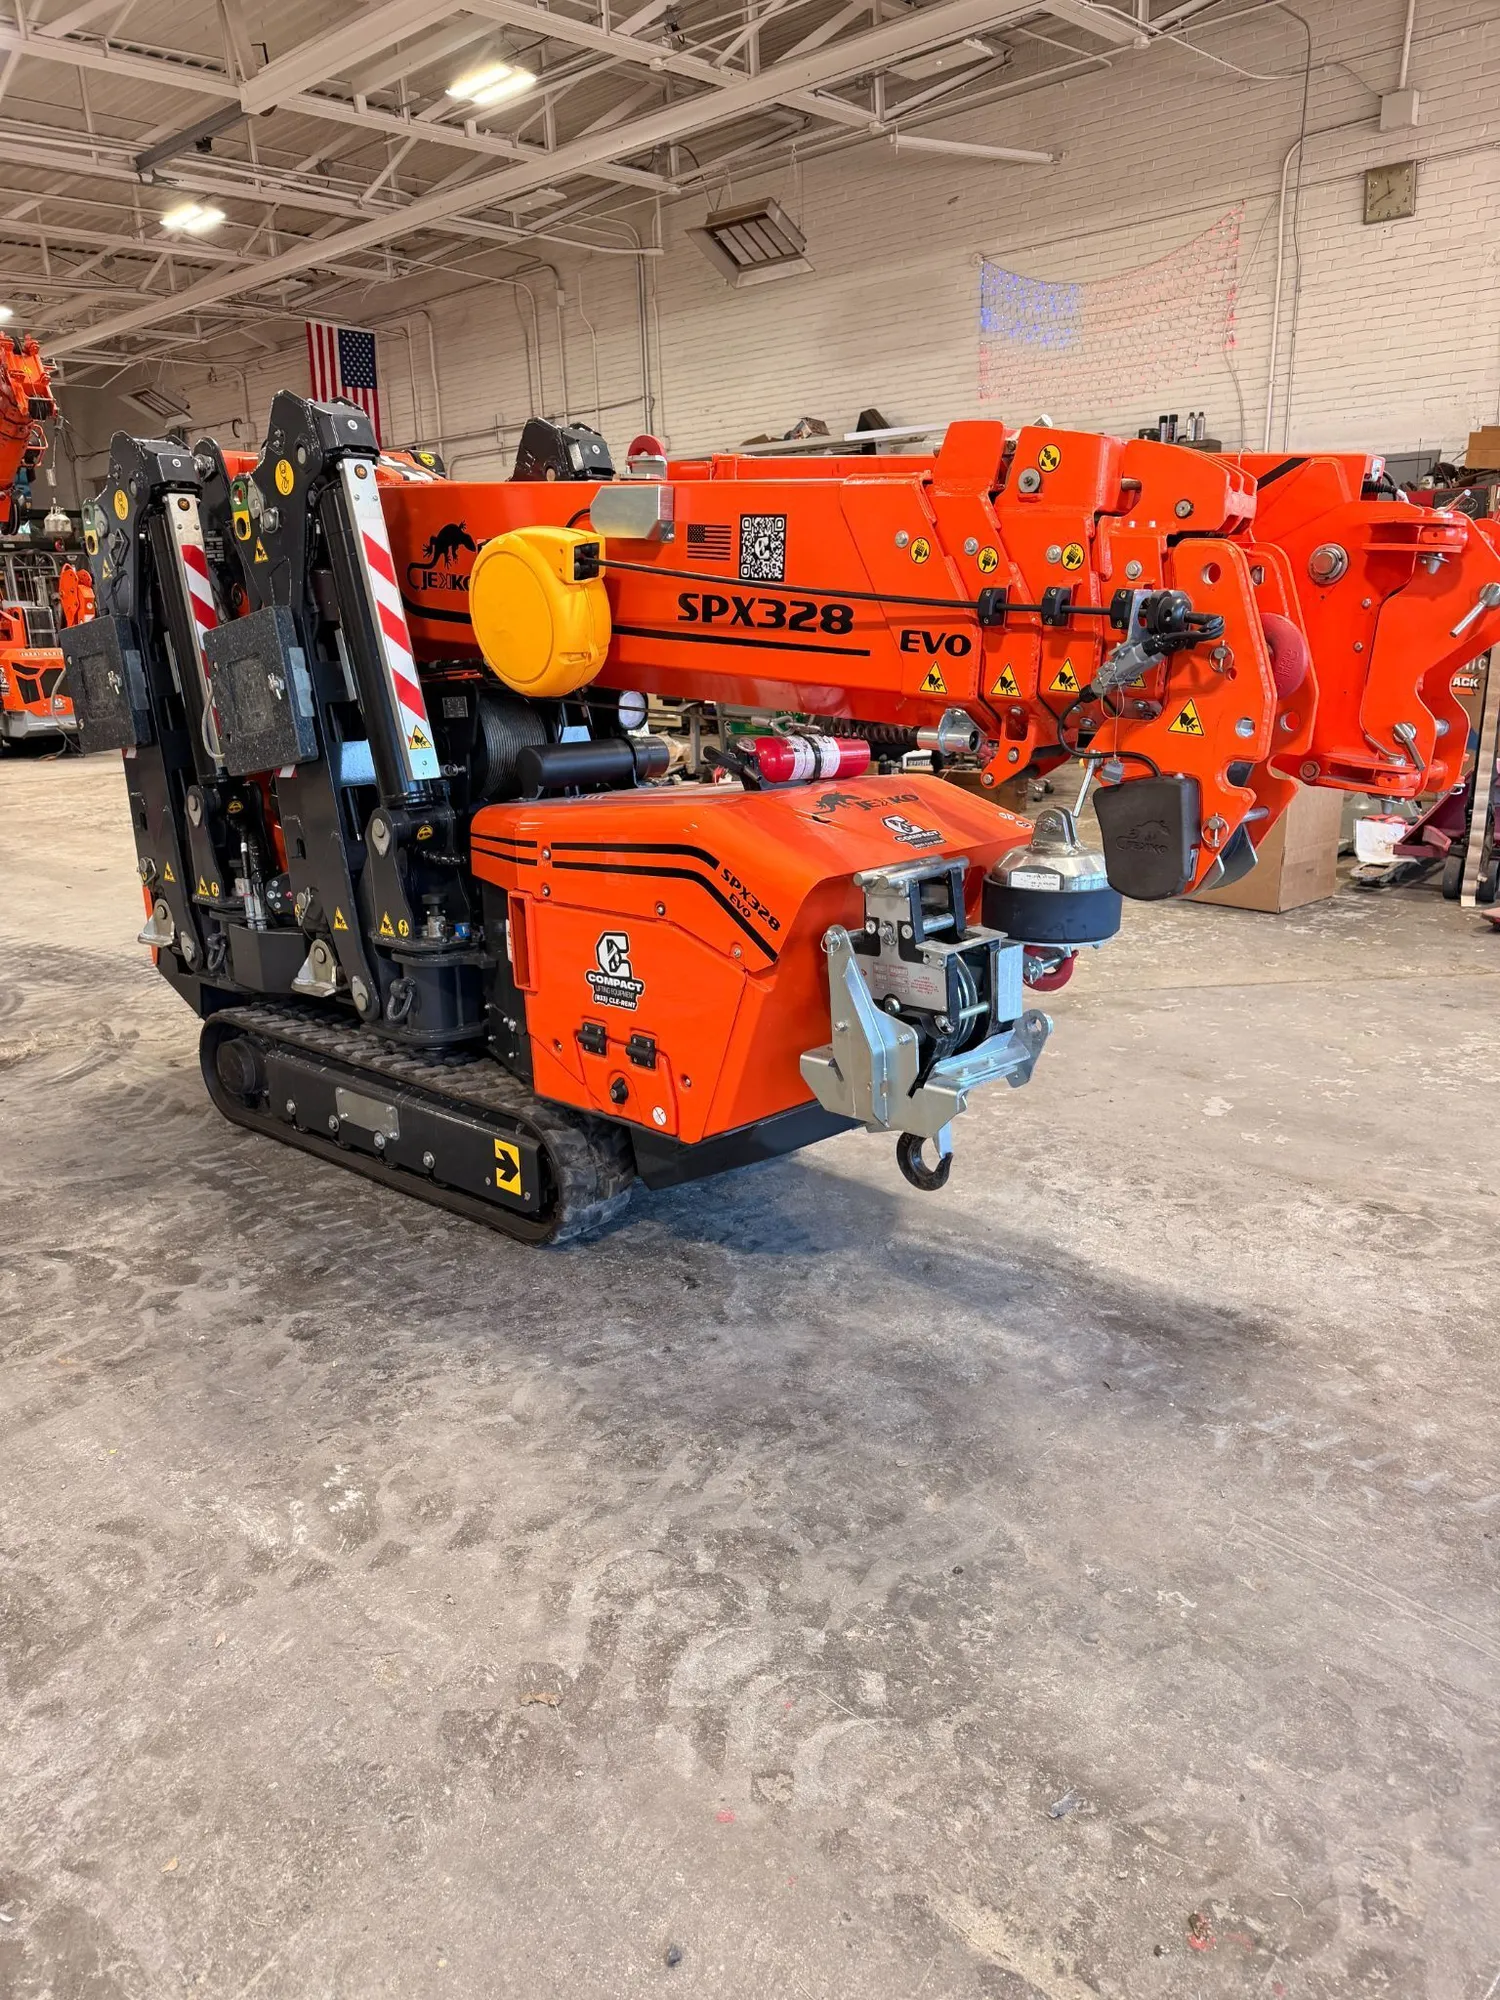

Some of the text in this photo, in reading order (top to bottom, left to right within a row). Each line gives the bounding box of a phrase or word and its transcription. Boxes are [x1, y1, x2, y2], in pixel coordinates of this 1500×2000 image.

[677, 592, 855, 635] SPX328
[900, 629, 972, 657] EVO
[721, 868, 781, 932] SPX328
[729, 893, 751, 918] EVO
[588, 974, 642, 991] COMPACT
[609, 997, 636, 1008] CLE-RENT
